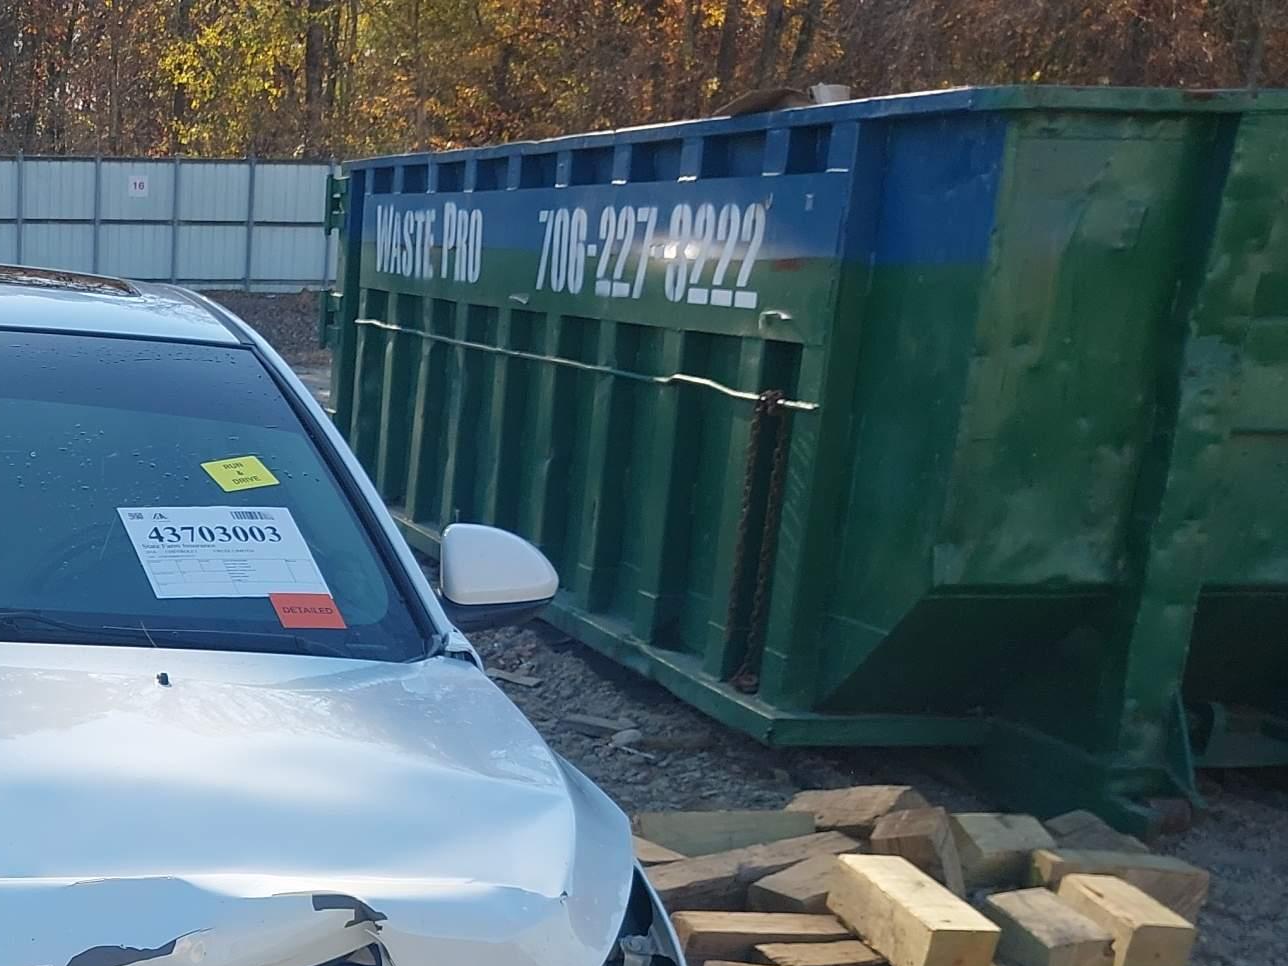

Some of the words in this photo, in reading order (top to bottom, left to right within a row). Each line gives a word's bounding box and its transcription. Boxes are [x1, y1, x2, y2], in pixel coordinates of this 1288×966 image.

[133, 181, 145, 191] 16
[375, 204, 436, 280] WASTE
[440, 201, 484, 284] PRO
[232, 475, 261, 485] DRIVE
[148, 526, 282, 543] 43703003
[281, 606, 334, 615] DETAILED
